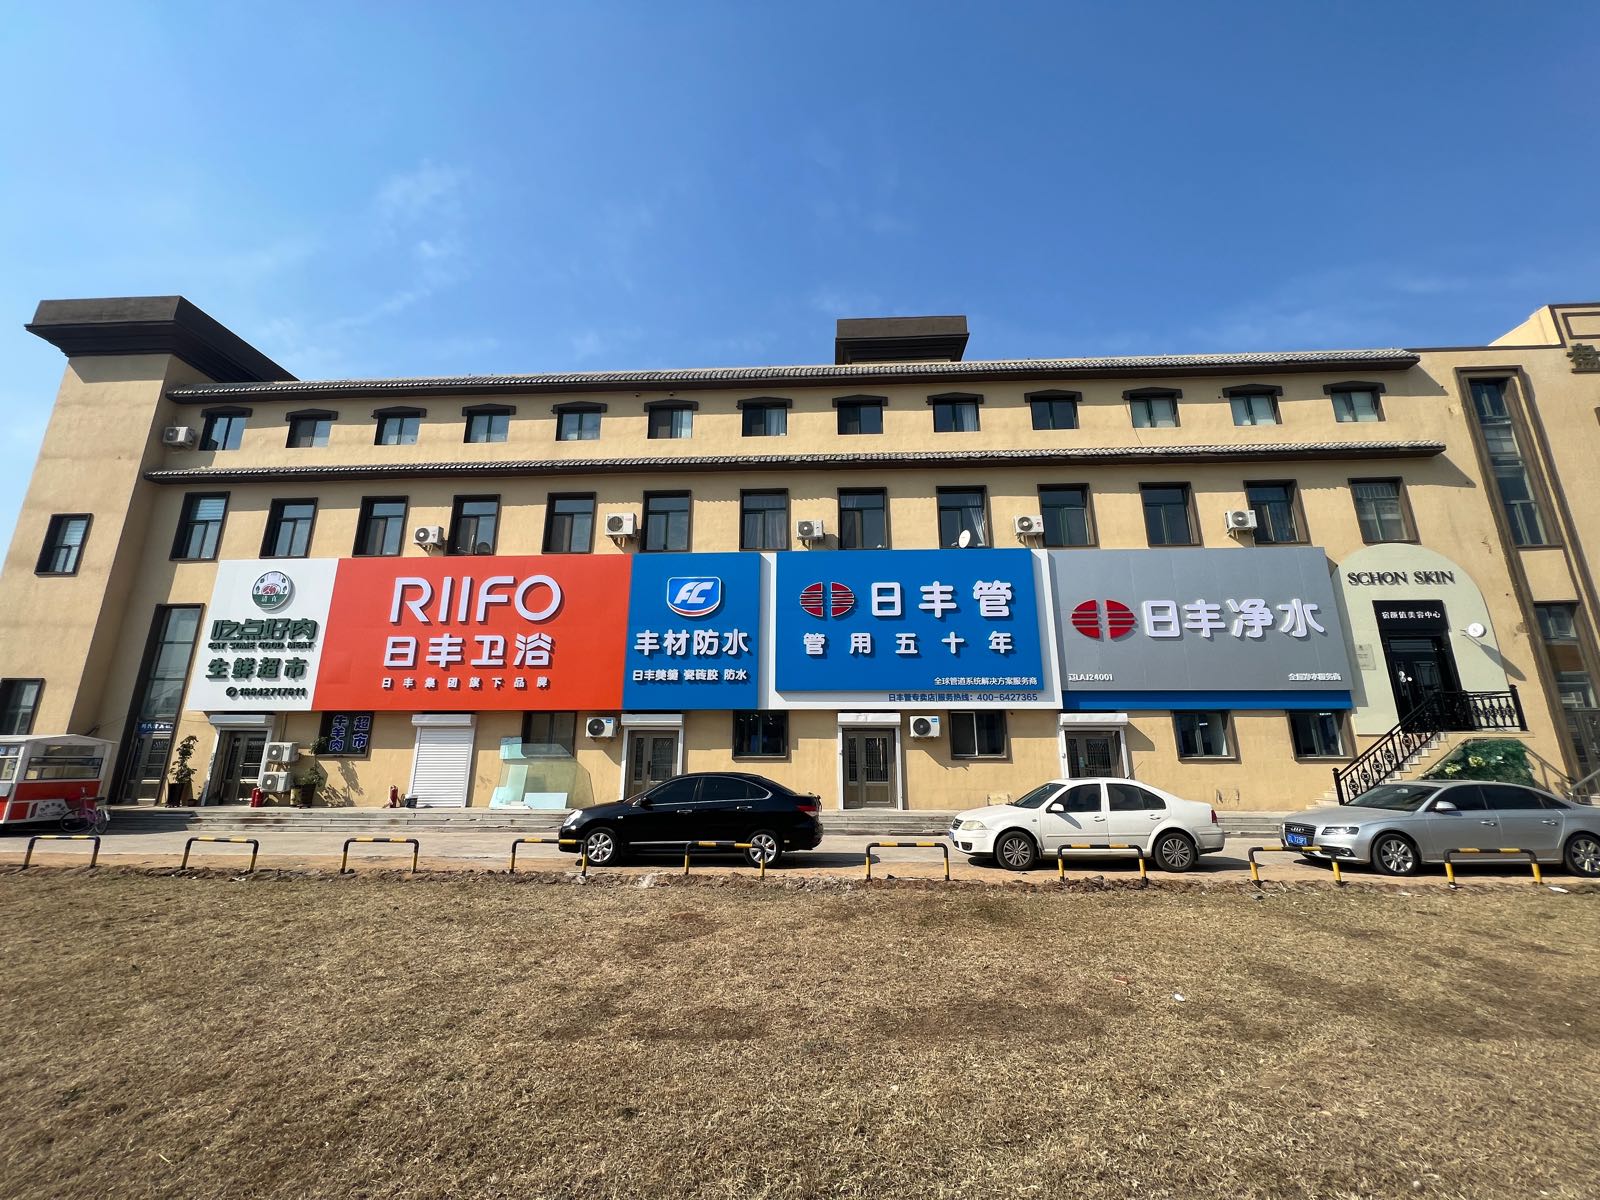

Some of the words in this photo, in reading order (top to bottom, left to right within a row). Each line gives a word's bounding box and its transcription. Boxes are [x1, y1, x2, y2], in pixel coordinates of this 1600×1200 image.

[1347, 571, 1407, 585] SCHON
[1414, 570, 1455, 584] SKIN
[389, 574, 562, 622] RIIFO
[870, 579, 1012, 618] 日丰管
[210, 617, 319, 641] 吃点好肉
[1142, 598, 1325, 639] 日丰净水
[258, 641, 285, 650] GOOD
[287, 641, 315, 650] MEAT
[383, 632, 553, 668] 日丰卫浴
[633, 628, 749, 656] 丰材防水
[803, 630, 1013, 655] 管用五十年
[205, 656, 307, 679] 生鲜超市
[723, 668, 748, 681] 防水
[381, 676, 549, 689] 日丰集团旗下品牌
[933, 676, 1038, 686] 全球管道系统解决方案服务商
[328, 714, 348, 752] 牛羊肉
[352, 715, 370, 749] 超市
